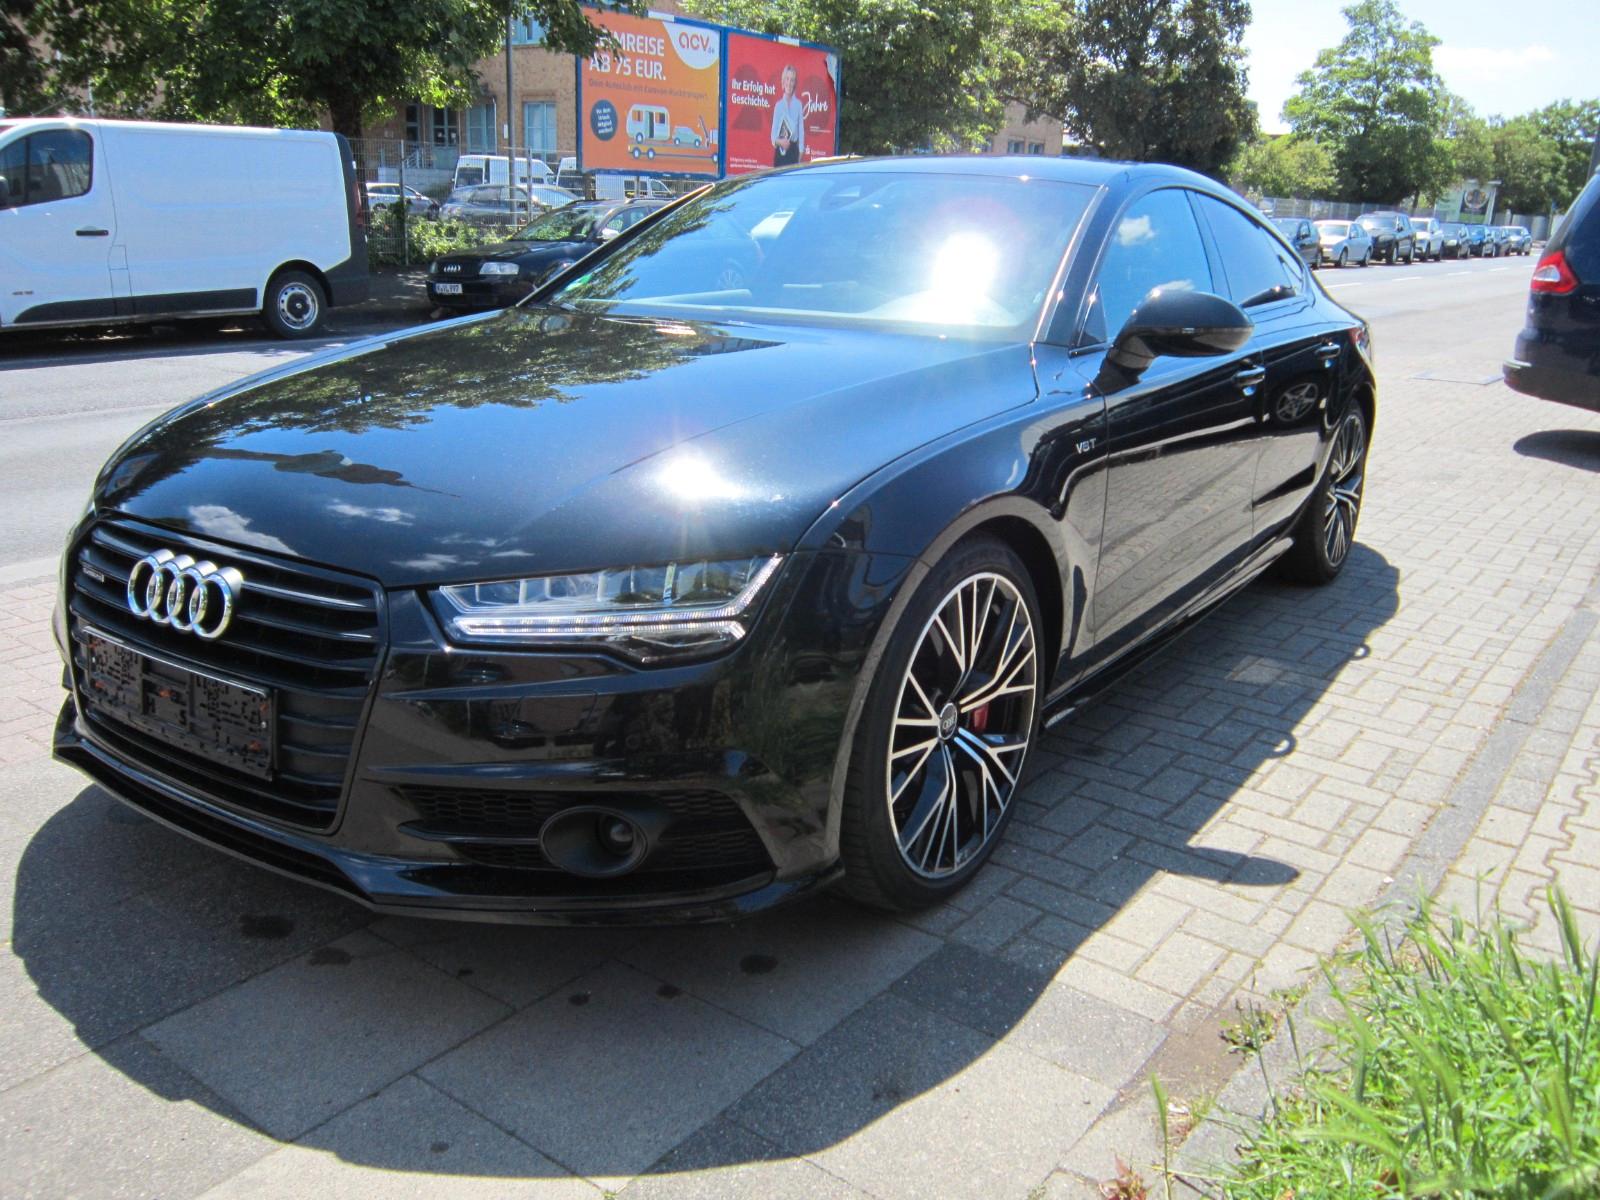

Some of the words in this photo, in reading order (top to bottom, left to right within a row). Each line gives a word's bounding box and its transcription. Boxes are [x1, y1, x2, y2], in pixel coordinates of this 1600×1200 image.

[589, 51, 611, 73] AB
[635, 59, 667, 81] EUR.
[731, 78, 742, 90] Ihr
[742, 80, 764, 96] Erfolg
[764, 83, 776, 95] hat
[731, 93, 770, 108] Geschichte.
[801, 91, 828, 120] Jahre
